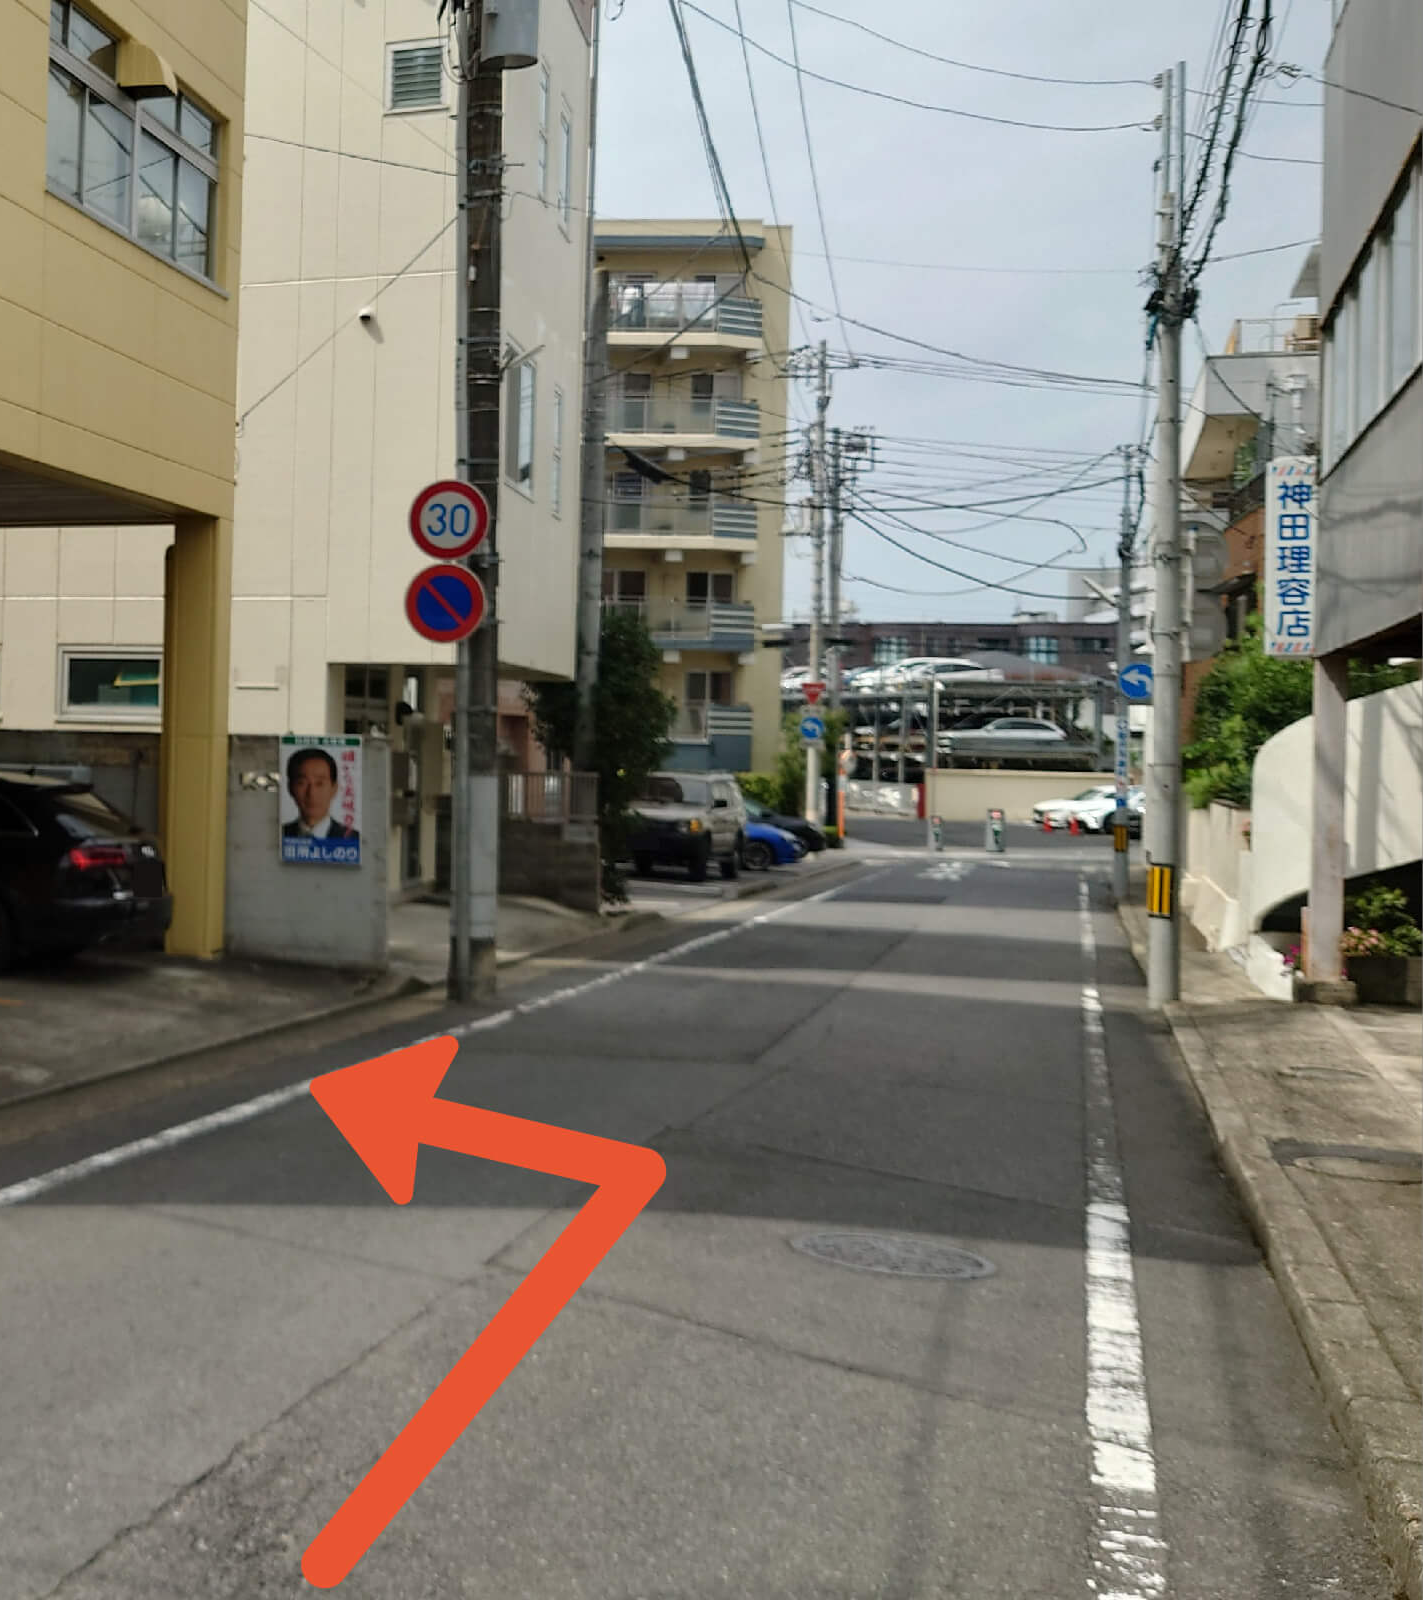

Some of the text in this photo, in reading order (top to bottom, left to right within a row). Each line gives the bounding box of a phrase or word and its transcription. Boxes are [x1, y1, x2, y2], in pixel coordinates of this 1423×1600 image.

[427, 503, 470, 537] 30
[1276, 480, 1312, 638] 神田理容店
